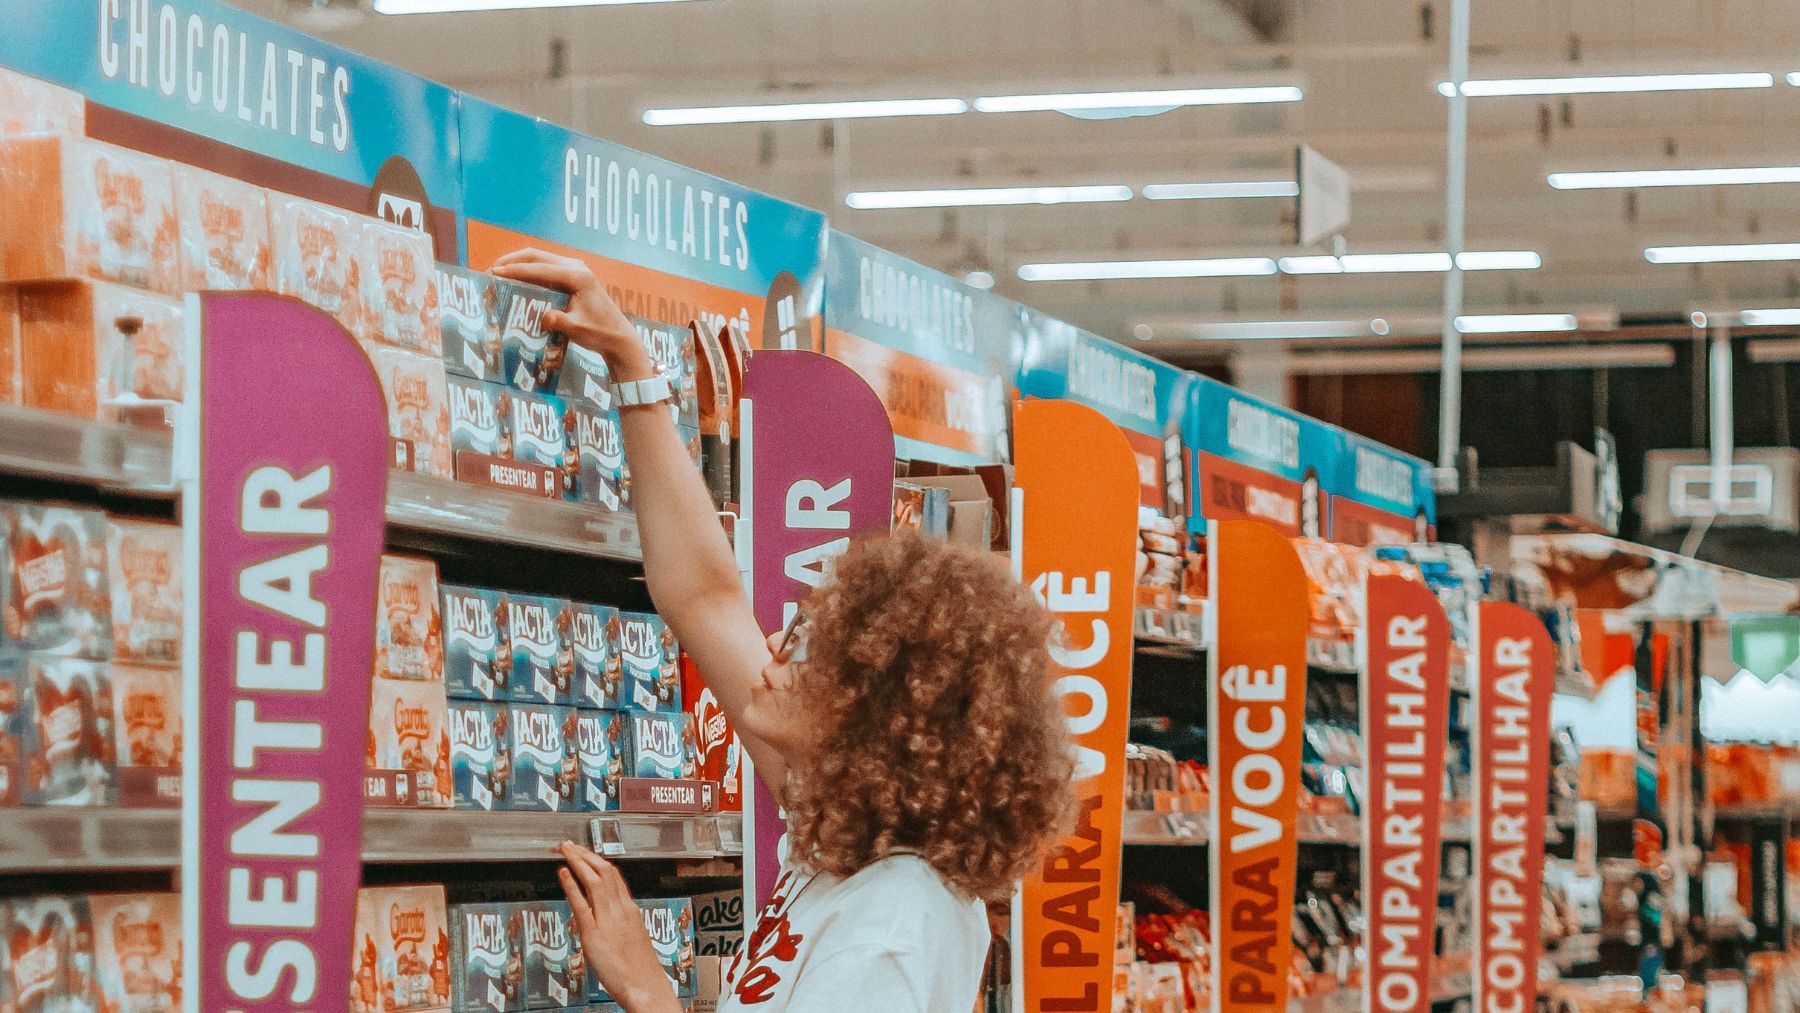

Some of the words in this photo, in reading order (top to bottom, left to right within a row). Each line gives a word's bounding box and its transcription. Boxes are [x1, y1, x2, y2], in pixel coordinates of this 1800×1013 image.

[99, 0, 351, 153] CHOCOLATES
[564, 147, 749, 272] CHOCOLATES
[435, 270, 483, 319] LACTA
[860, 256, 976, 354] CHOCOLATES
[636, 325, 680, 368] ACTA
[447, 383, 496, 431] LACTA
[512, 398, 561, 446] LACTA
[576, 411, 620, 459] LACTA
[490, 463, 538, 490] PRESENTEAR
[446, 594, 494, 642] LACTA
[508, 603, 556, 648] LACTA
[225, 463, 332, 1013] SENTEAR
[448, 708, 492, 754] LACTA
[512, 709, 560, 755] LACTA
[635, 717, 680, 760] LACTA
[1220, 664, 1287, 854] VOCÊ
[651, 786, 695, 805] PRESENTEAR
[1379, 614, 1428, 1011] OMPARTILHAR
[1487, 636, 1533, 1013] COMPARTILHAR
[466, 913, 506, 957] LACTA
[521, 910, 566, 953] LACTA
[640, 907, 676, 941] ACTA
[1229, 857, 1280, 1006] PARA
